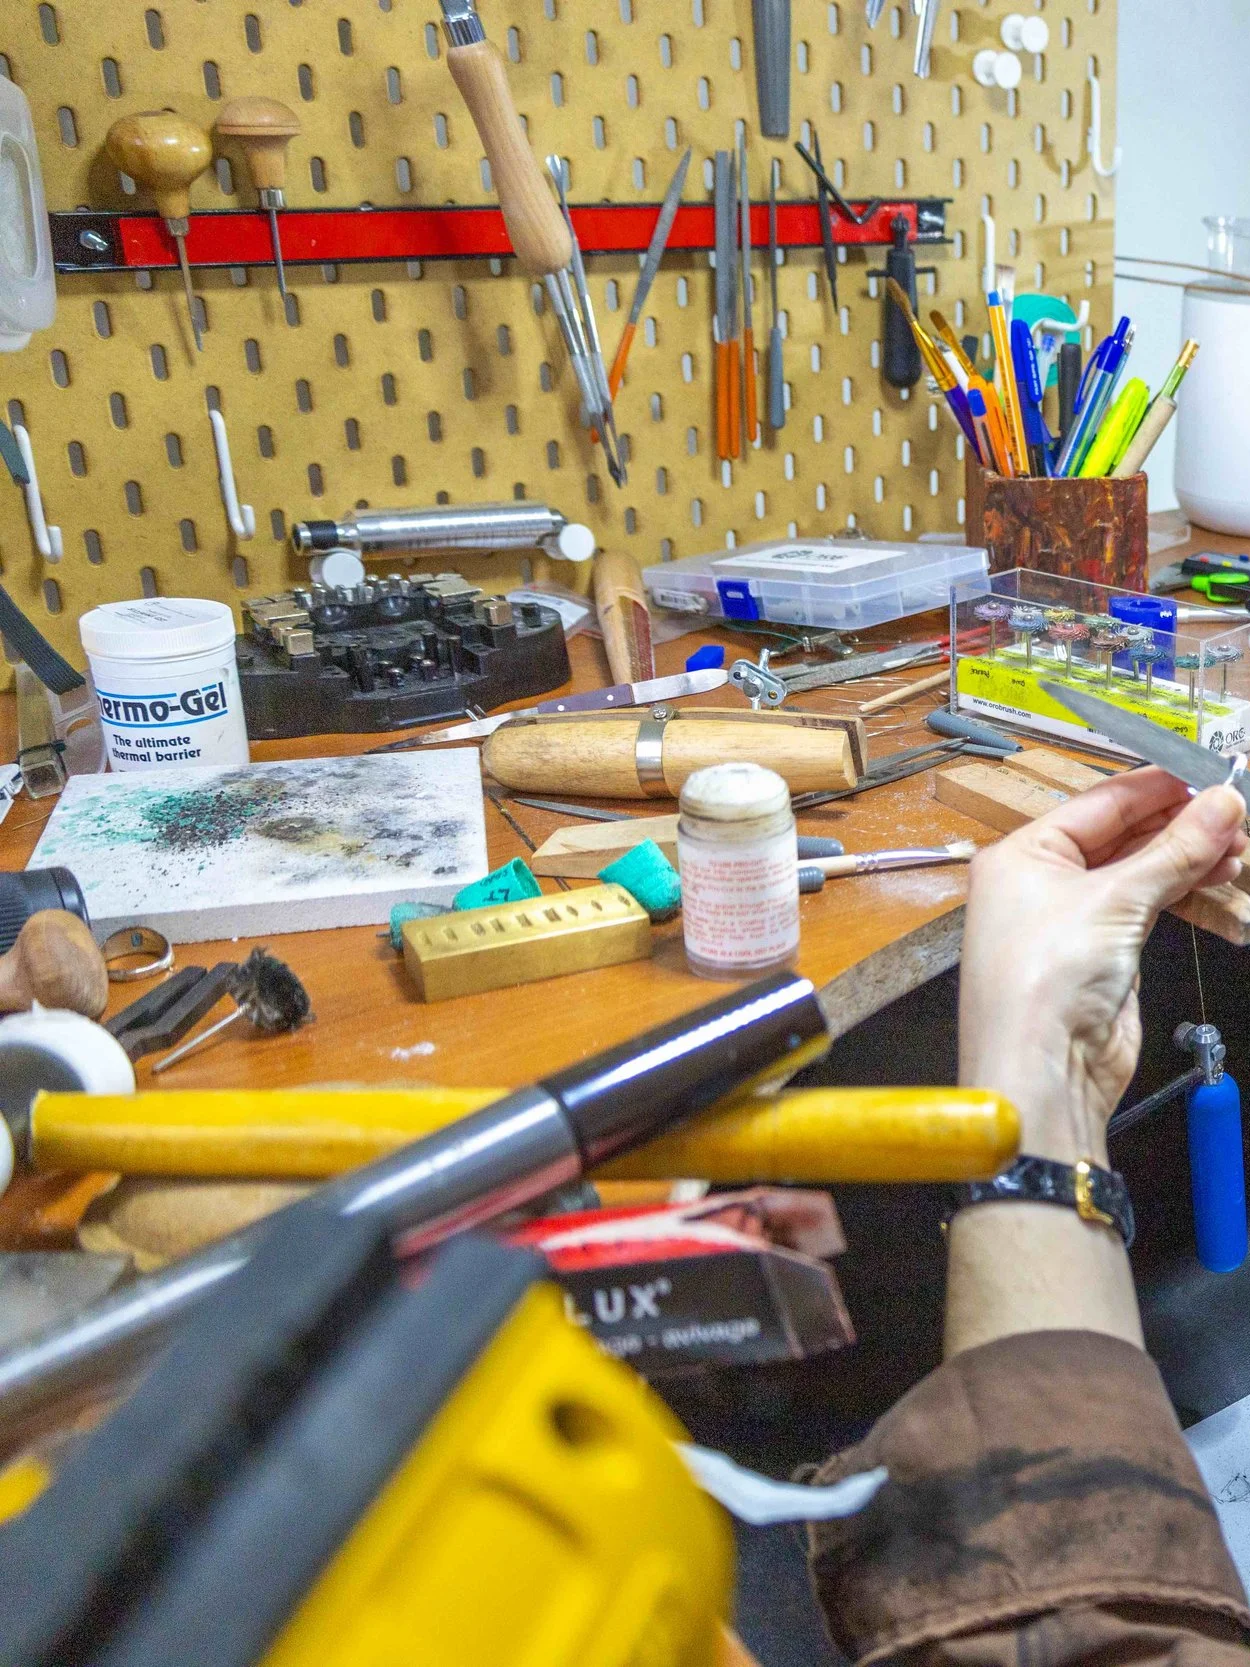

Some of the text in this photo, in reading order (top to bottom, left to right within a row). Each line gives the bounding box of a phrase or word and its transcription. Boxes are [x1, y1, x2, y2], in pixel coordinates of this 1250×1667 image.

[972, 698, 1032, 719] www.orobrush.com
[112, 733, 191, 749] The ultimate
[112, 747, 202, 763] thermal barrier
